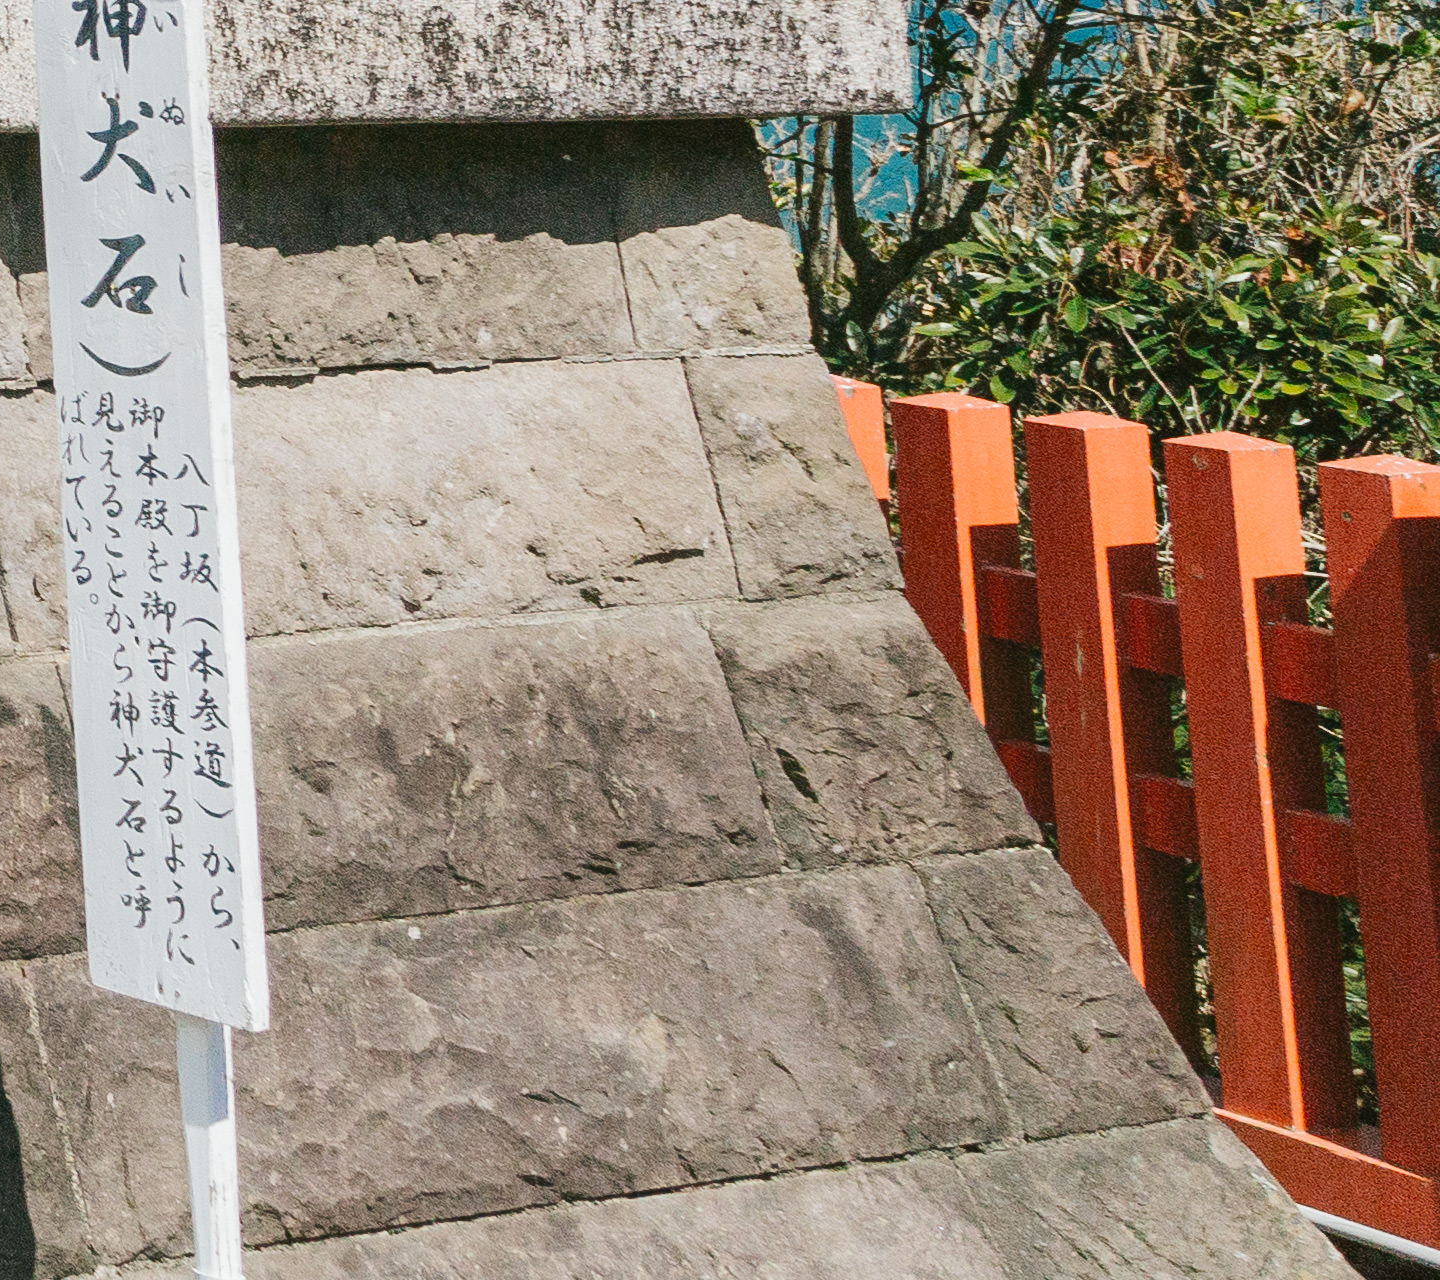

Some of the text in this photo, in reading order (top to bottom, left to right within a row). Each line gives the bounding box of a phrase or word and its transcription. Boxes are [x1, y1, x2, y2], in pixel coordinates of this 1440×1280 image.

[59, 389, 100, 606] ばれている。
